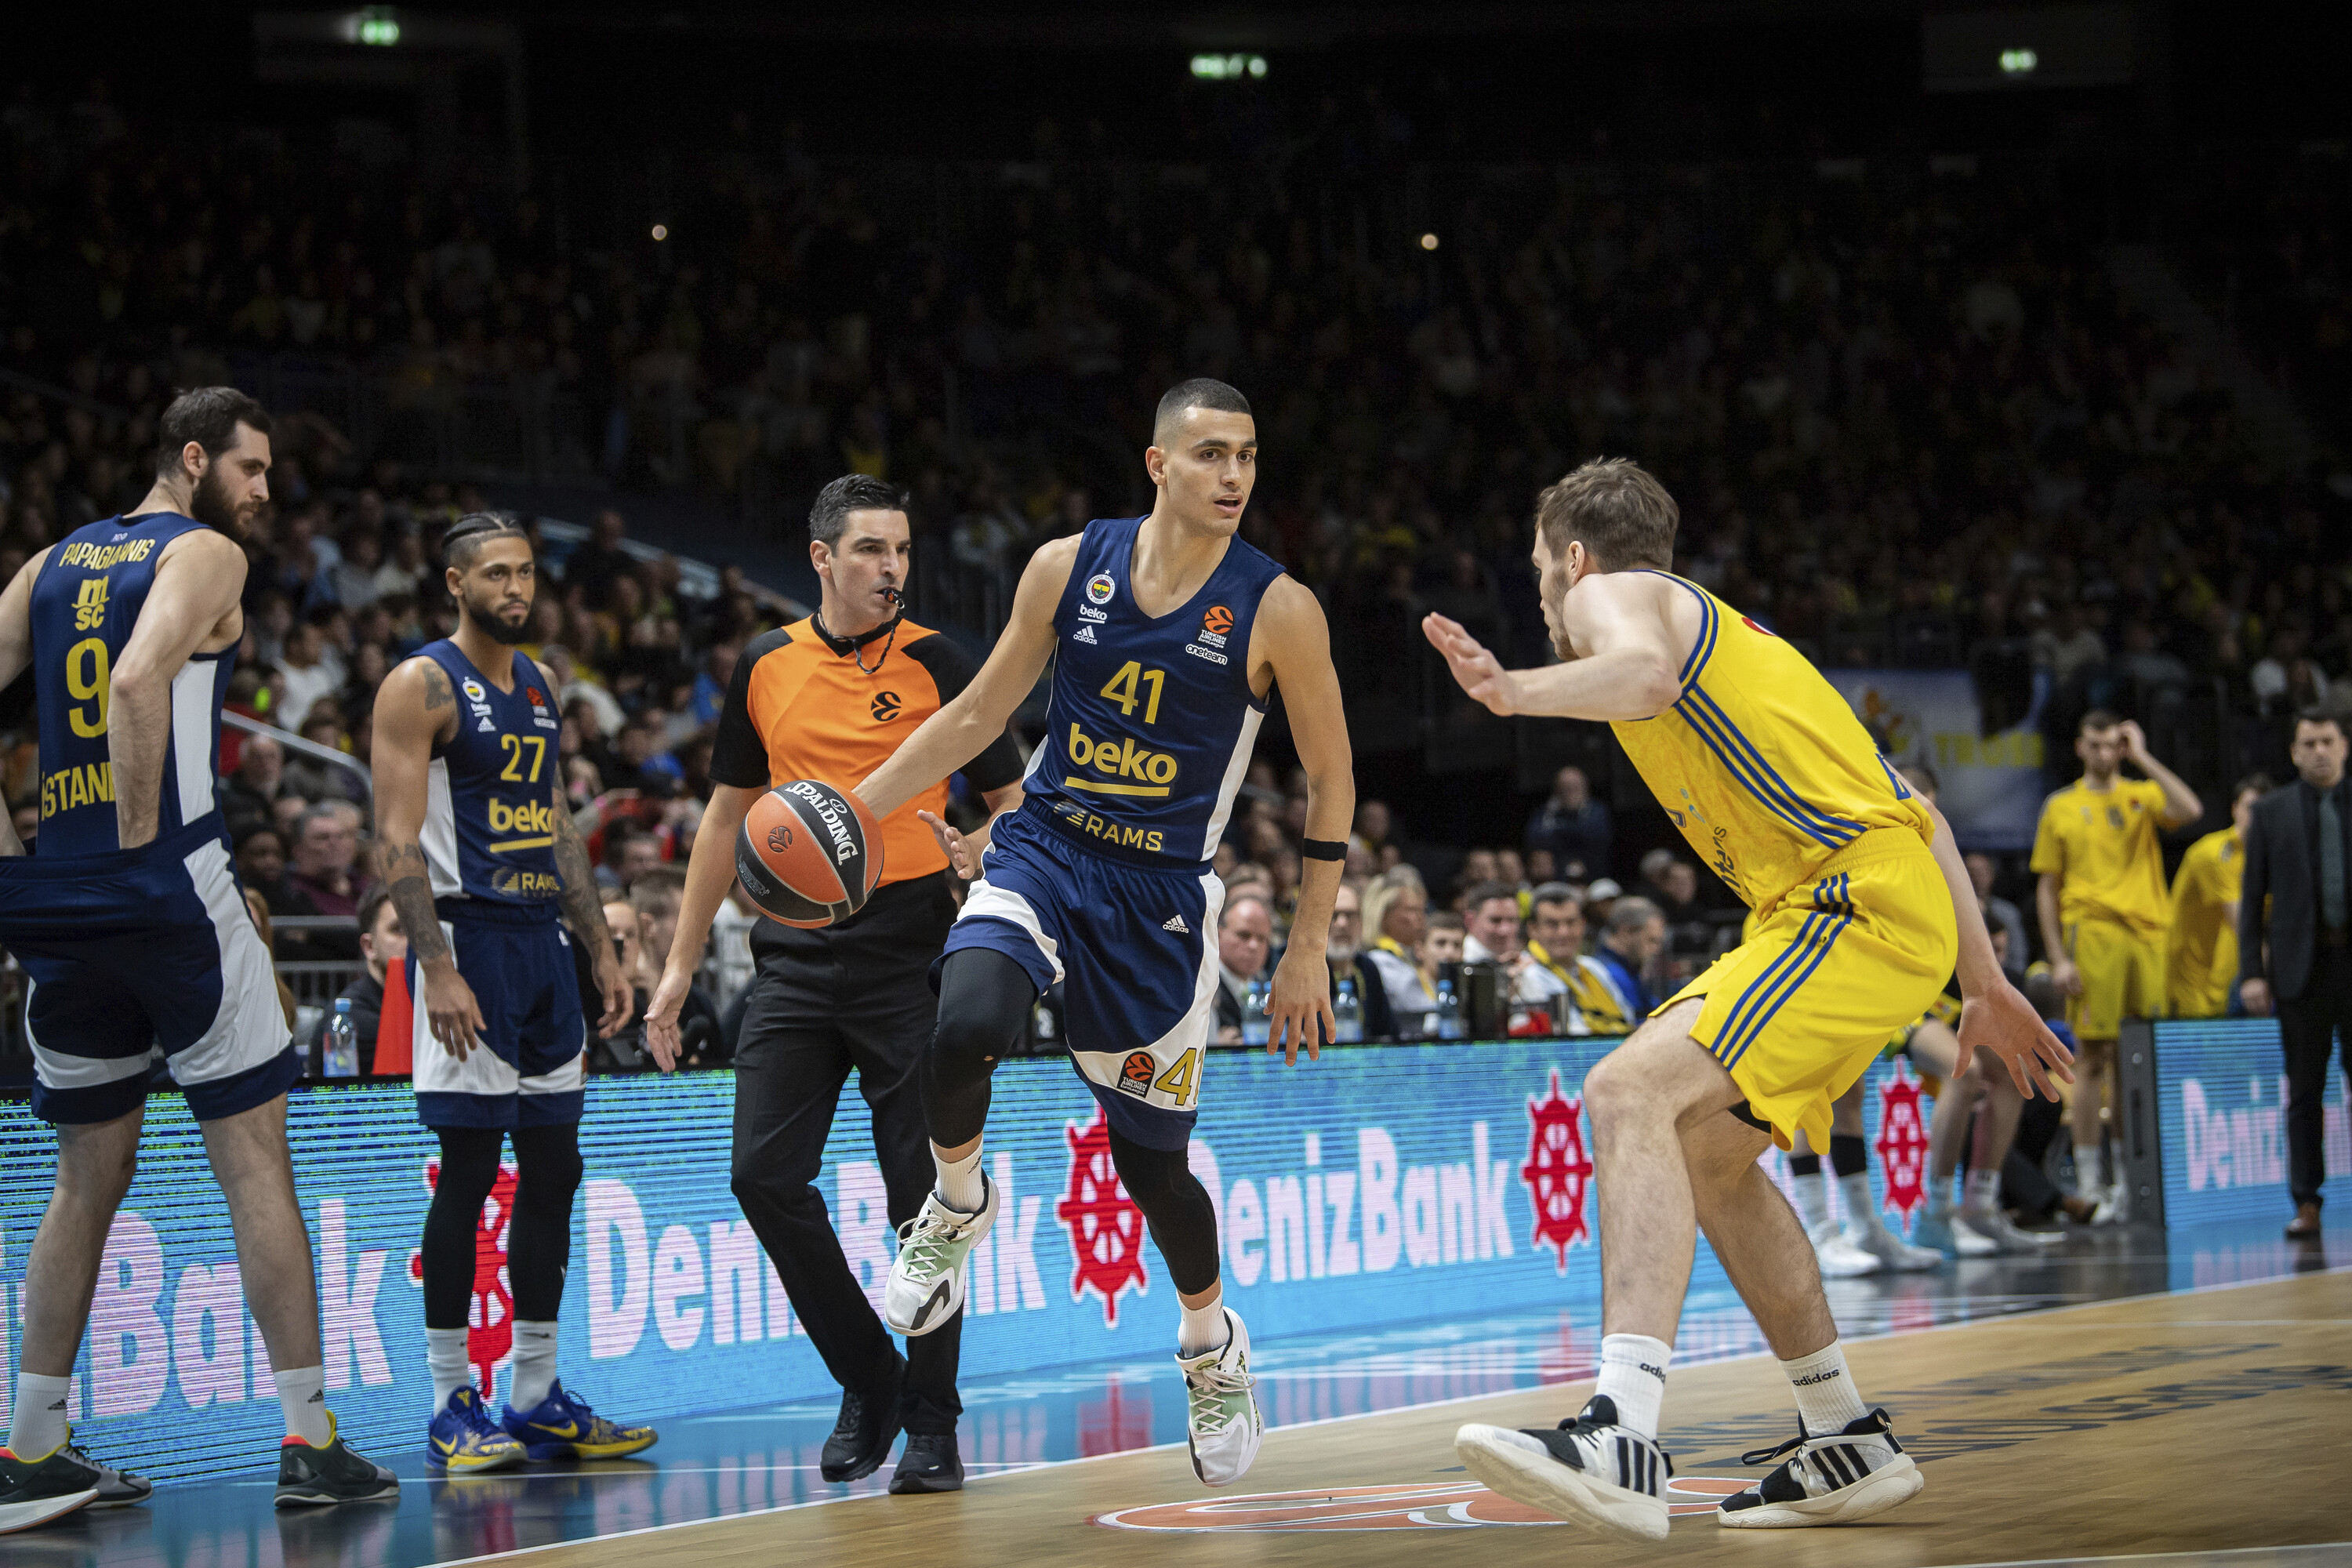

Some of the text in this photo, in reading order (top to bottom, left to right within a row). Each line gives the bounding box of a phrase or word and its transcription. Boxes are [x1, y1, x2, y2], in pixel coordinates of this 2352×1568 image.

[59, 539, 156, 571] PAPAGIANNIS
[1080, 604, 1108, 621] beko
[1073, 633, 1098, 645] adidas
[1200, 634, 1225, 645] AIRLINES
[1201, 630, 1227, 641] TURKISH
[1185, 644, 1228, 665] oneteam
[66, 637, 110, 739] 9
[1100, 660, 1165, 725] 41
[500, 734, 546, 783] 27
[1069, 722, 1178, 784] beko
[41, 761, 116, 822] İSTAN
[785, 782, 858, 866] SPALDING
[1085, 814, 1163, 852] RAMS
[1163, 923, 1189, 934] adidas
[1121, 1081, 1145, 1092] AIRLINES
[1123, 1076, 1148, 1088] TURKISH
[1792, 1367, 1839, 1387] adidas
